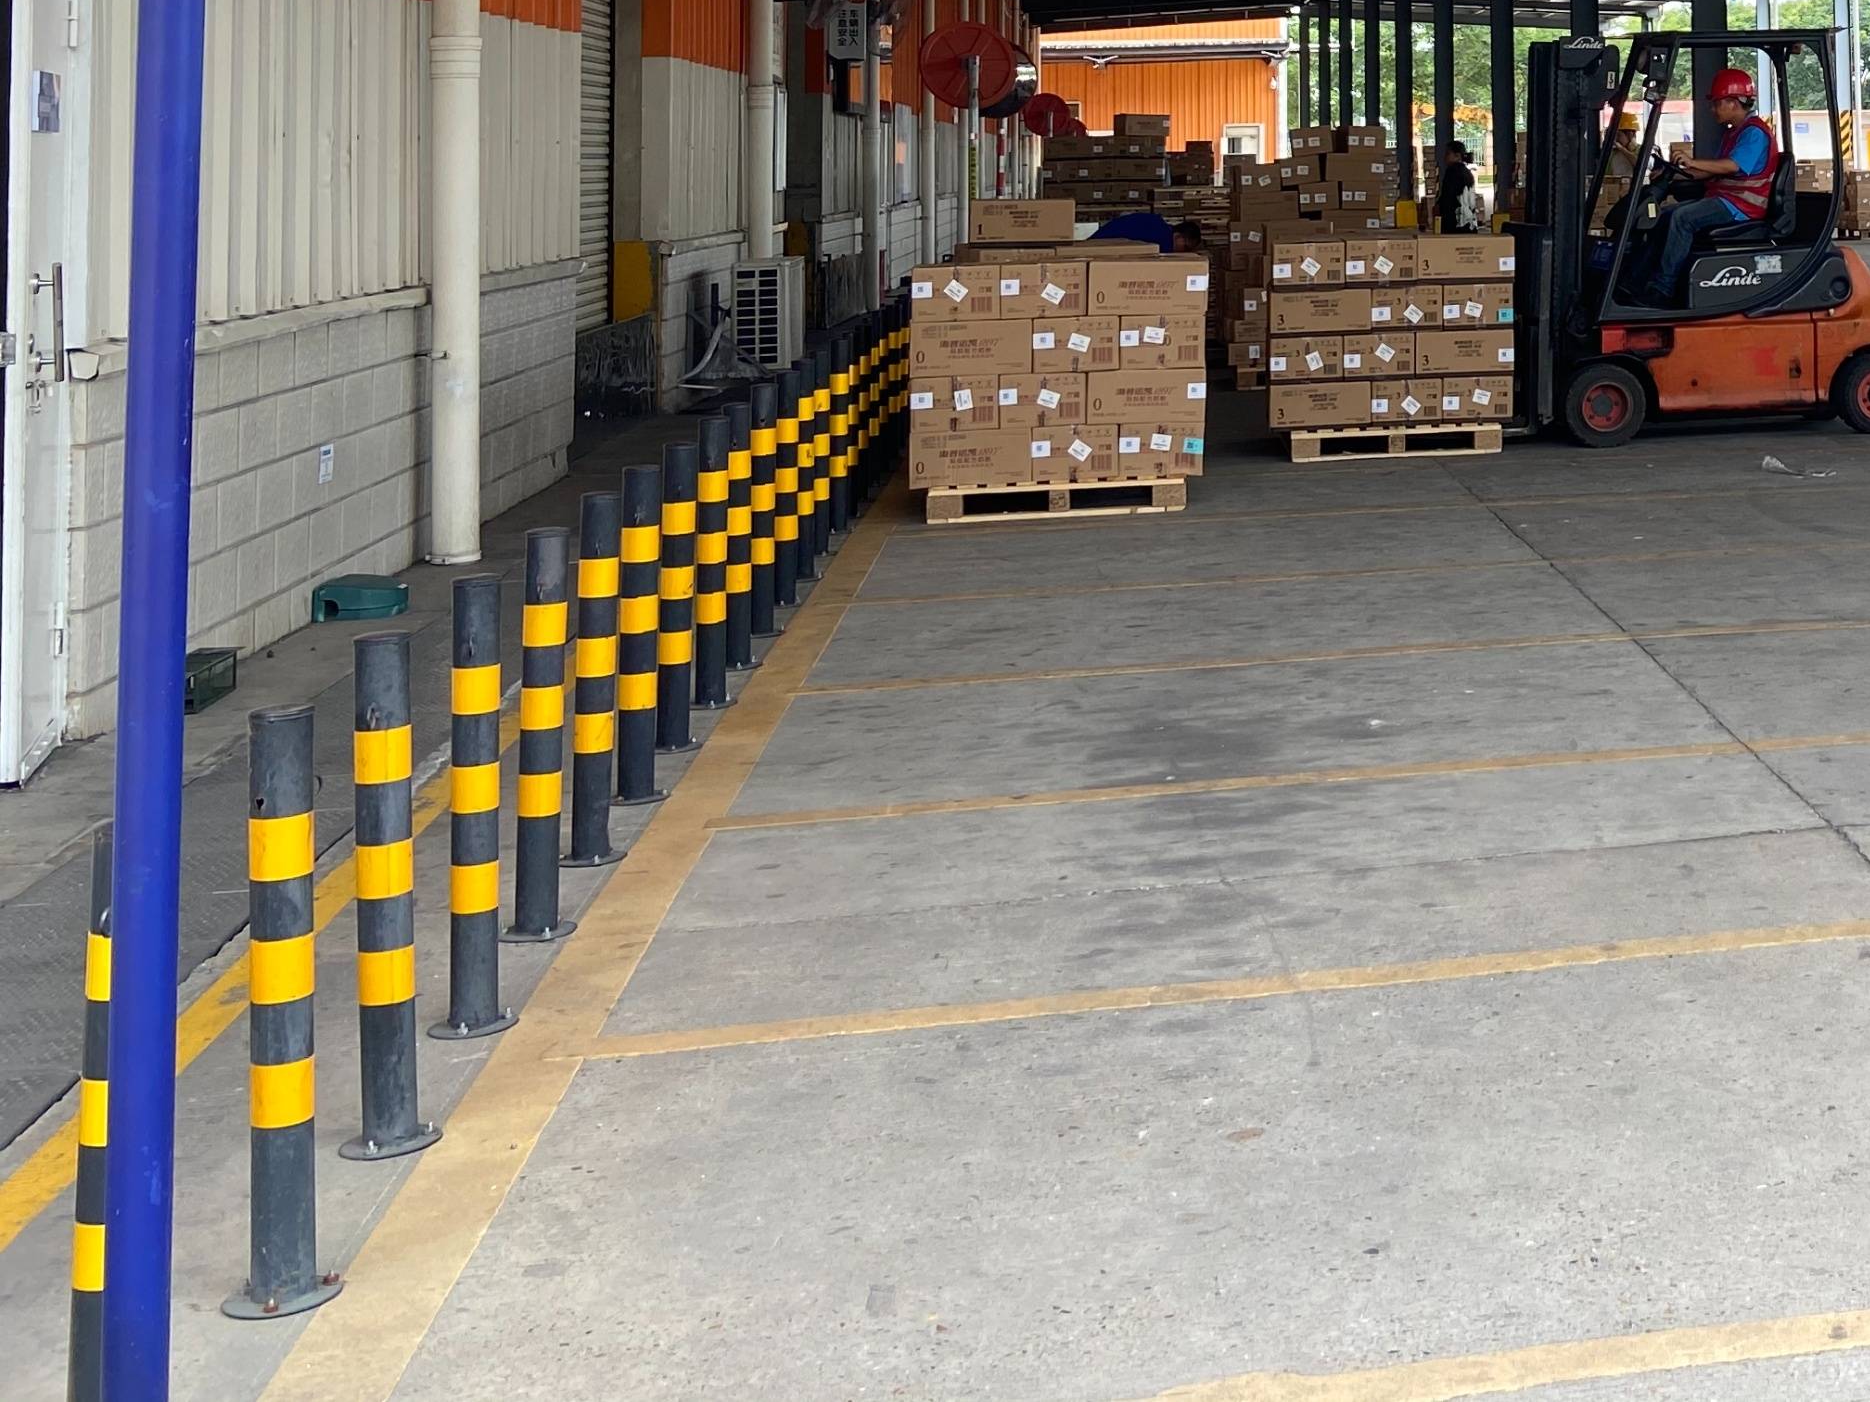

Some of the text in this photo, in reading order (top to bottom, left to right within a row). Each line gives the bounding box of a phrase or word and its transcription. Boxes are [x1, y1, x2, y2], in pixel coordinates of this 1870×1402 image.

[1563, 36, 1604, 50] Linde
[1422, 260, 1430, 271] 3
[1699, 266, 1761, 287] Linde
[1096, 291, 1105, 304] 0
[1277, 314, 1285, 326] 3
[915, 350, 925, 364] 0
[1422, 355, 1430, 367] 3
[1093, 398, 1102, 411] 0
[1277, 408, 1285, 420] 3
[915, 461, 925, 475] 0
